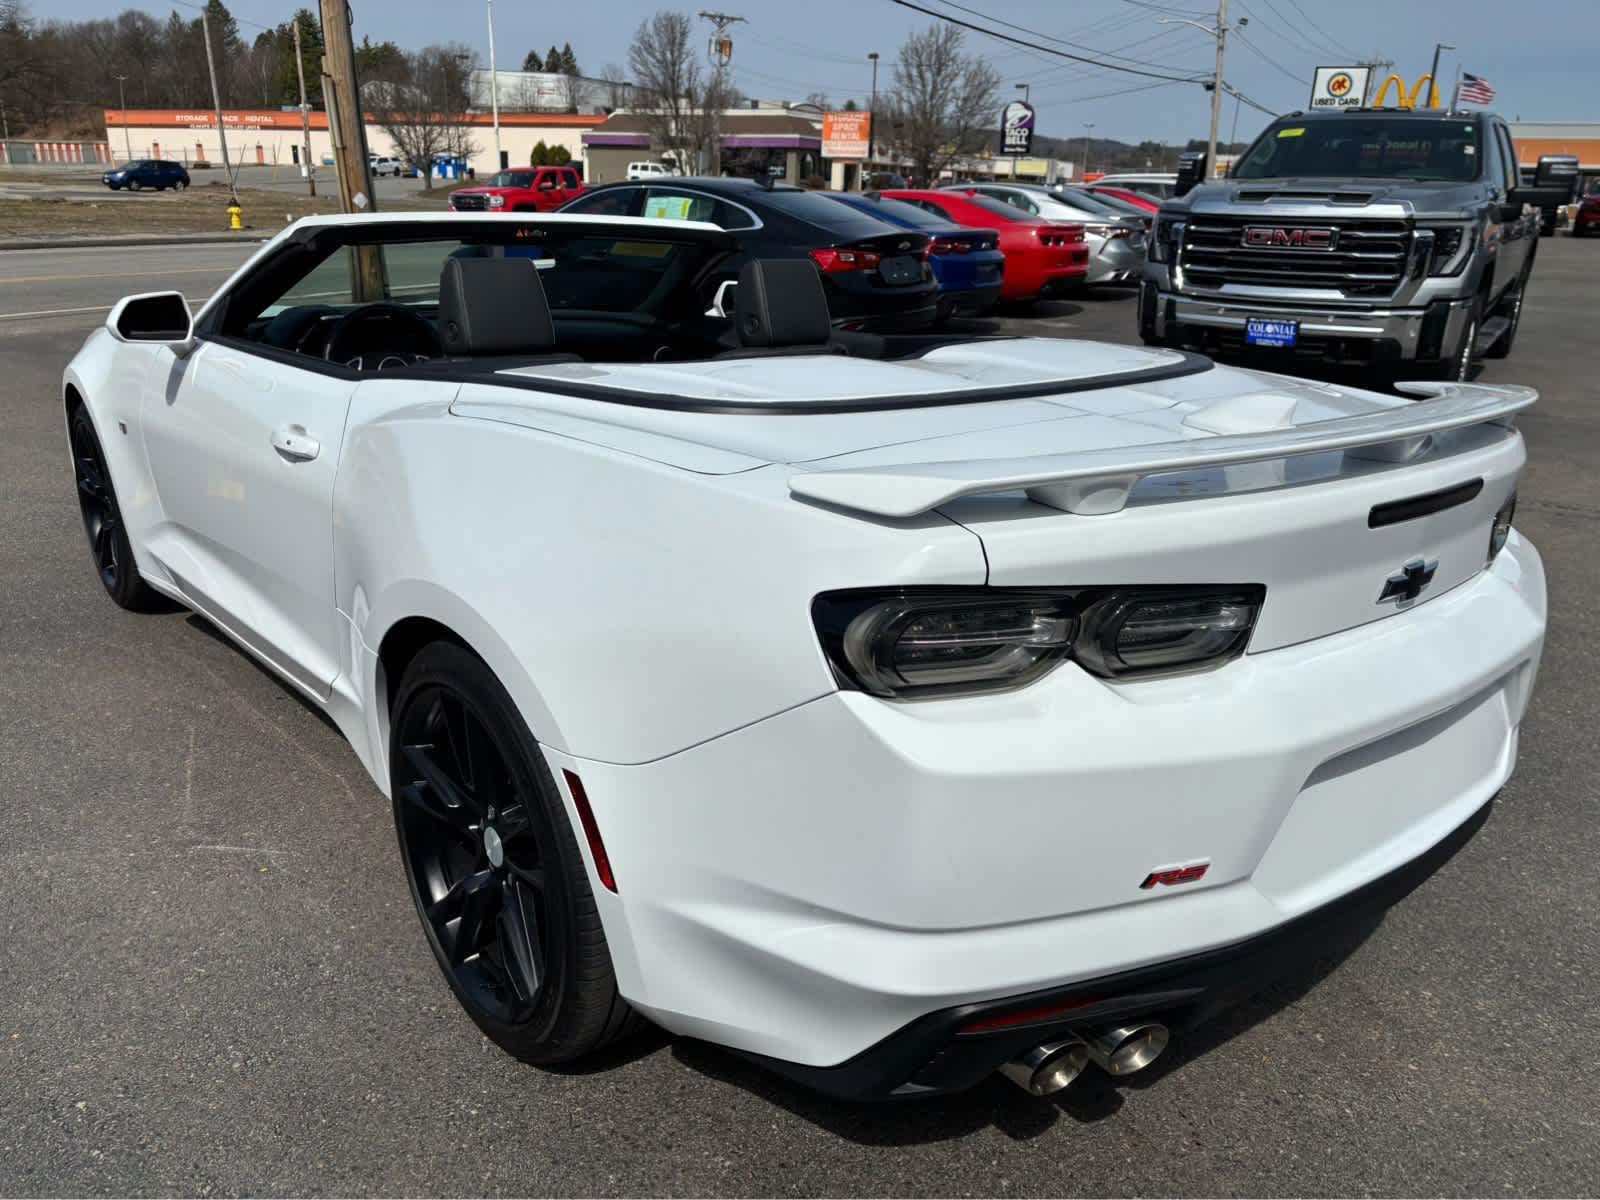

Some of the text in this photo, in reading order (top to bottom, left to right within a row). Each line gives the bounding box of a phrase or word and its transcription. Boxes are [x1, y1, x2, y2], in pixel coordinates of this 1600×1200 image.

[1331, 77, 1347, 93] OK
[1314, 97, 1360, 106] USED CARS
[832, 122, 860, 130] SPACE
[830, 131, 860, 140] RENTAL
[1005, 128, 1029, 137] TACO
[1005, 136, 1028, 145] BELL
[1247, 228, 1331, 247] GMC
[1138, 863, 1210, 889] RS
